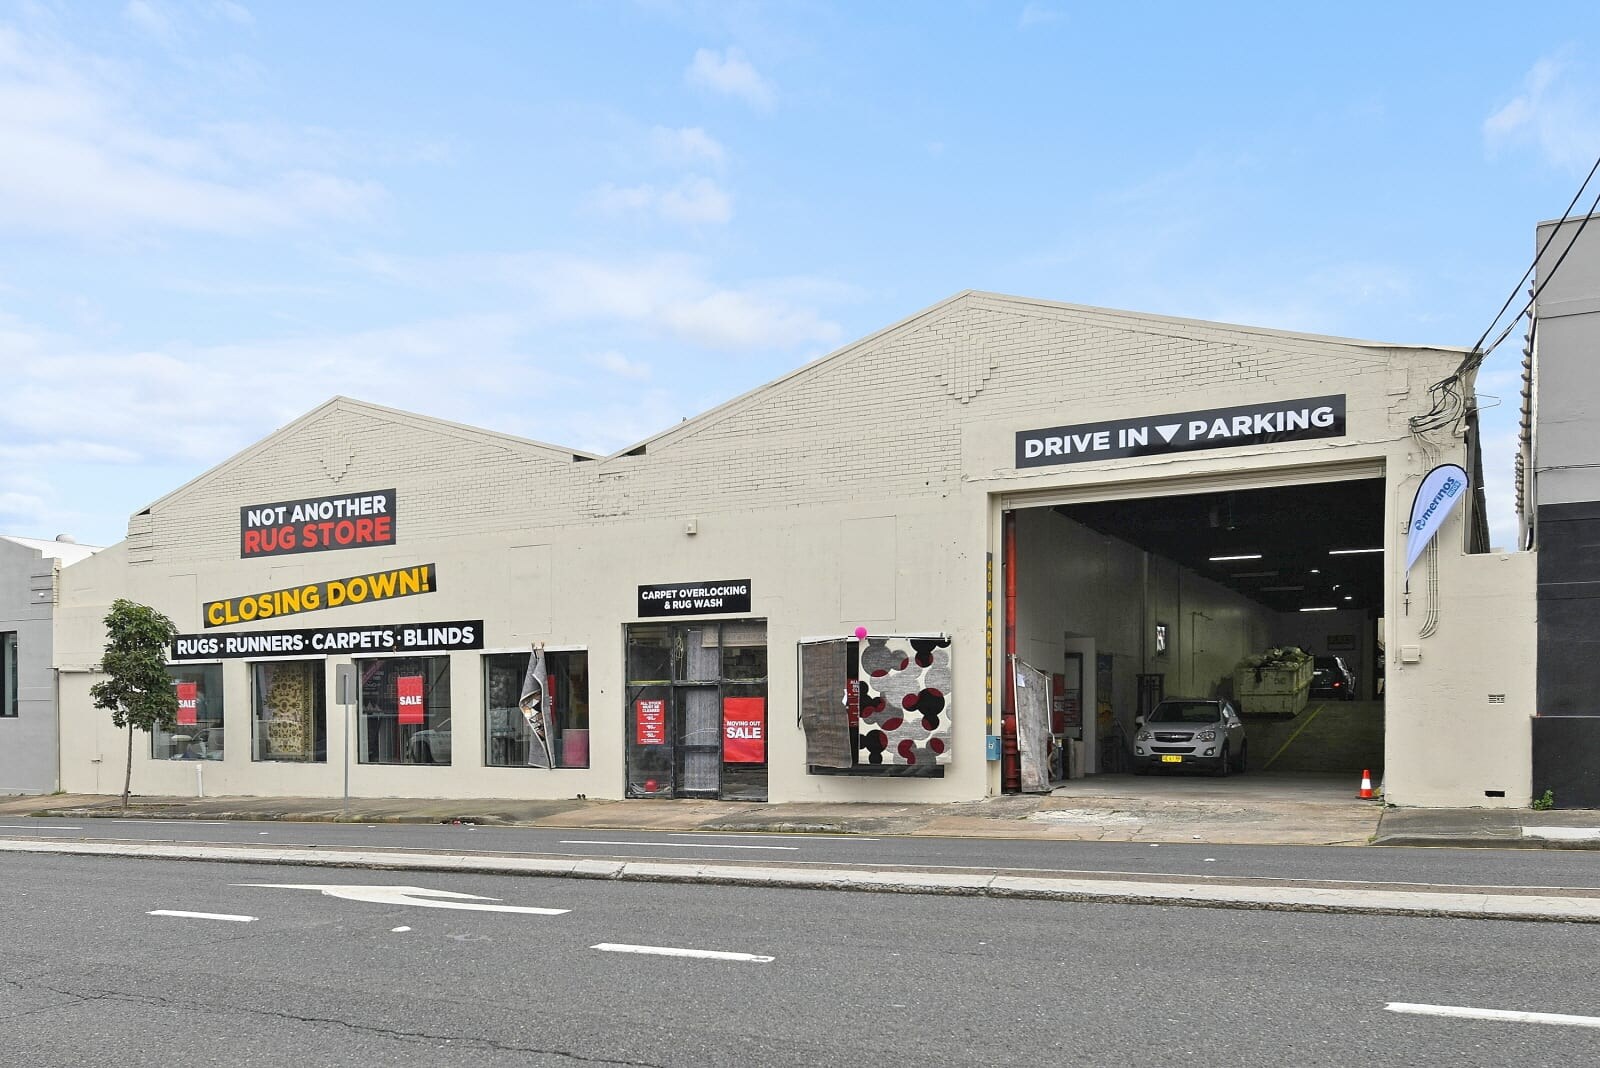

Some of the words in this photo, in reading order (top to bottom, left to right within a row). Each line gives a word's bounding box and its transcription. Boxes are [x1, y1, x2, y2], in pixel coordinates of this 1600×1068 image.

[1024, 431, 1110, 459] DRIVE
[1118, 427, 1148, 449] IN
[1188, 406, 1334, 441] PARKING
[248, 506, 286, 528] NOT
[291, 495, 387, 523] ANOTHER
[1422, 477, 1454, 521] merinos
[244, 525, 296, 554] RUG
[302, 516, 391, 548] STORE
[207, 589, 320, 626] CLOSING
[327, 566, 429, 607] DOWN!
[641, 590, 677, 600] CARPET
[679, 585, 747, 598] OVERLOCKING
[664, 601, 671, 610] &
[672, 600, 692, 609] RUG
[693, 598, 723, 609] WASH
[177, 638, 218, 655] RUGS
[226, 634, 303, 653] RUNNERS
[311, 631, 394, 650] CARPETS
[403, 626, 475, 646] BLINDS
[178, 699, 196, 708] SALE
[399, 695, 422, 705] SALE
[726, 727, 762, 739] SALE
